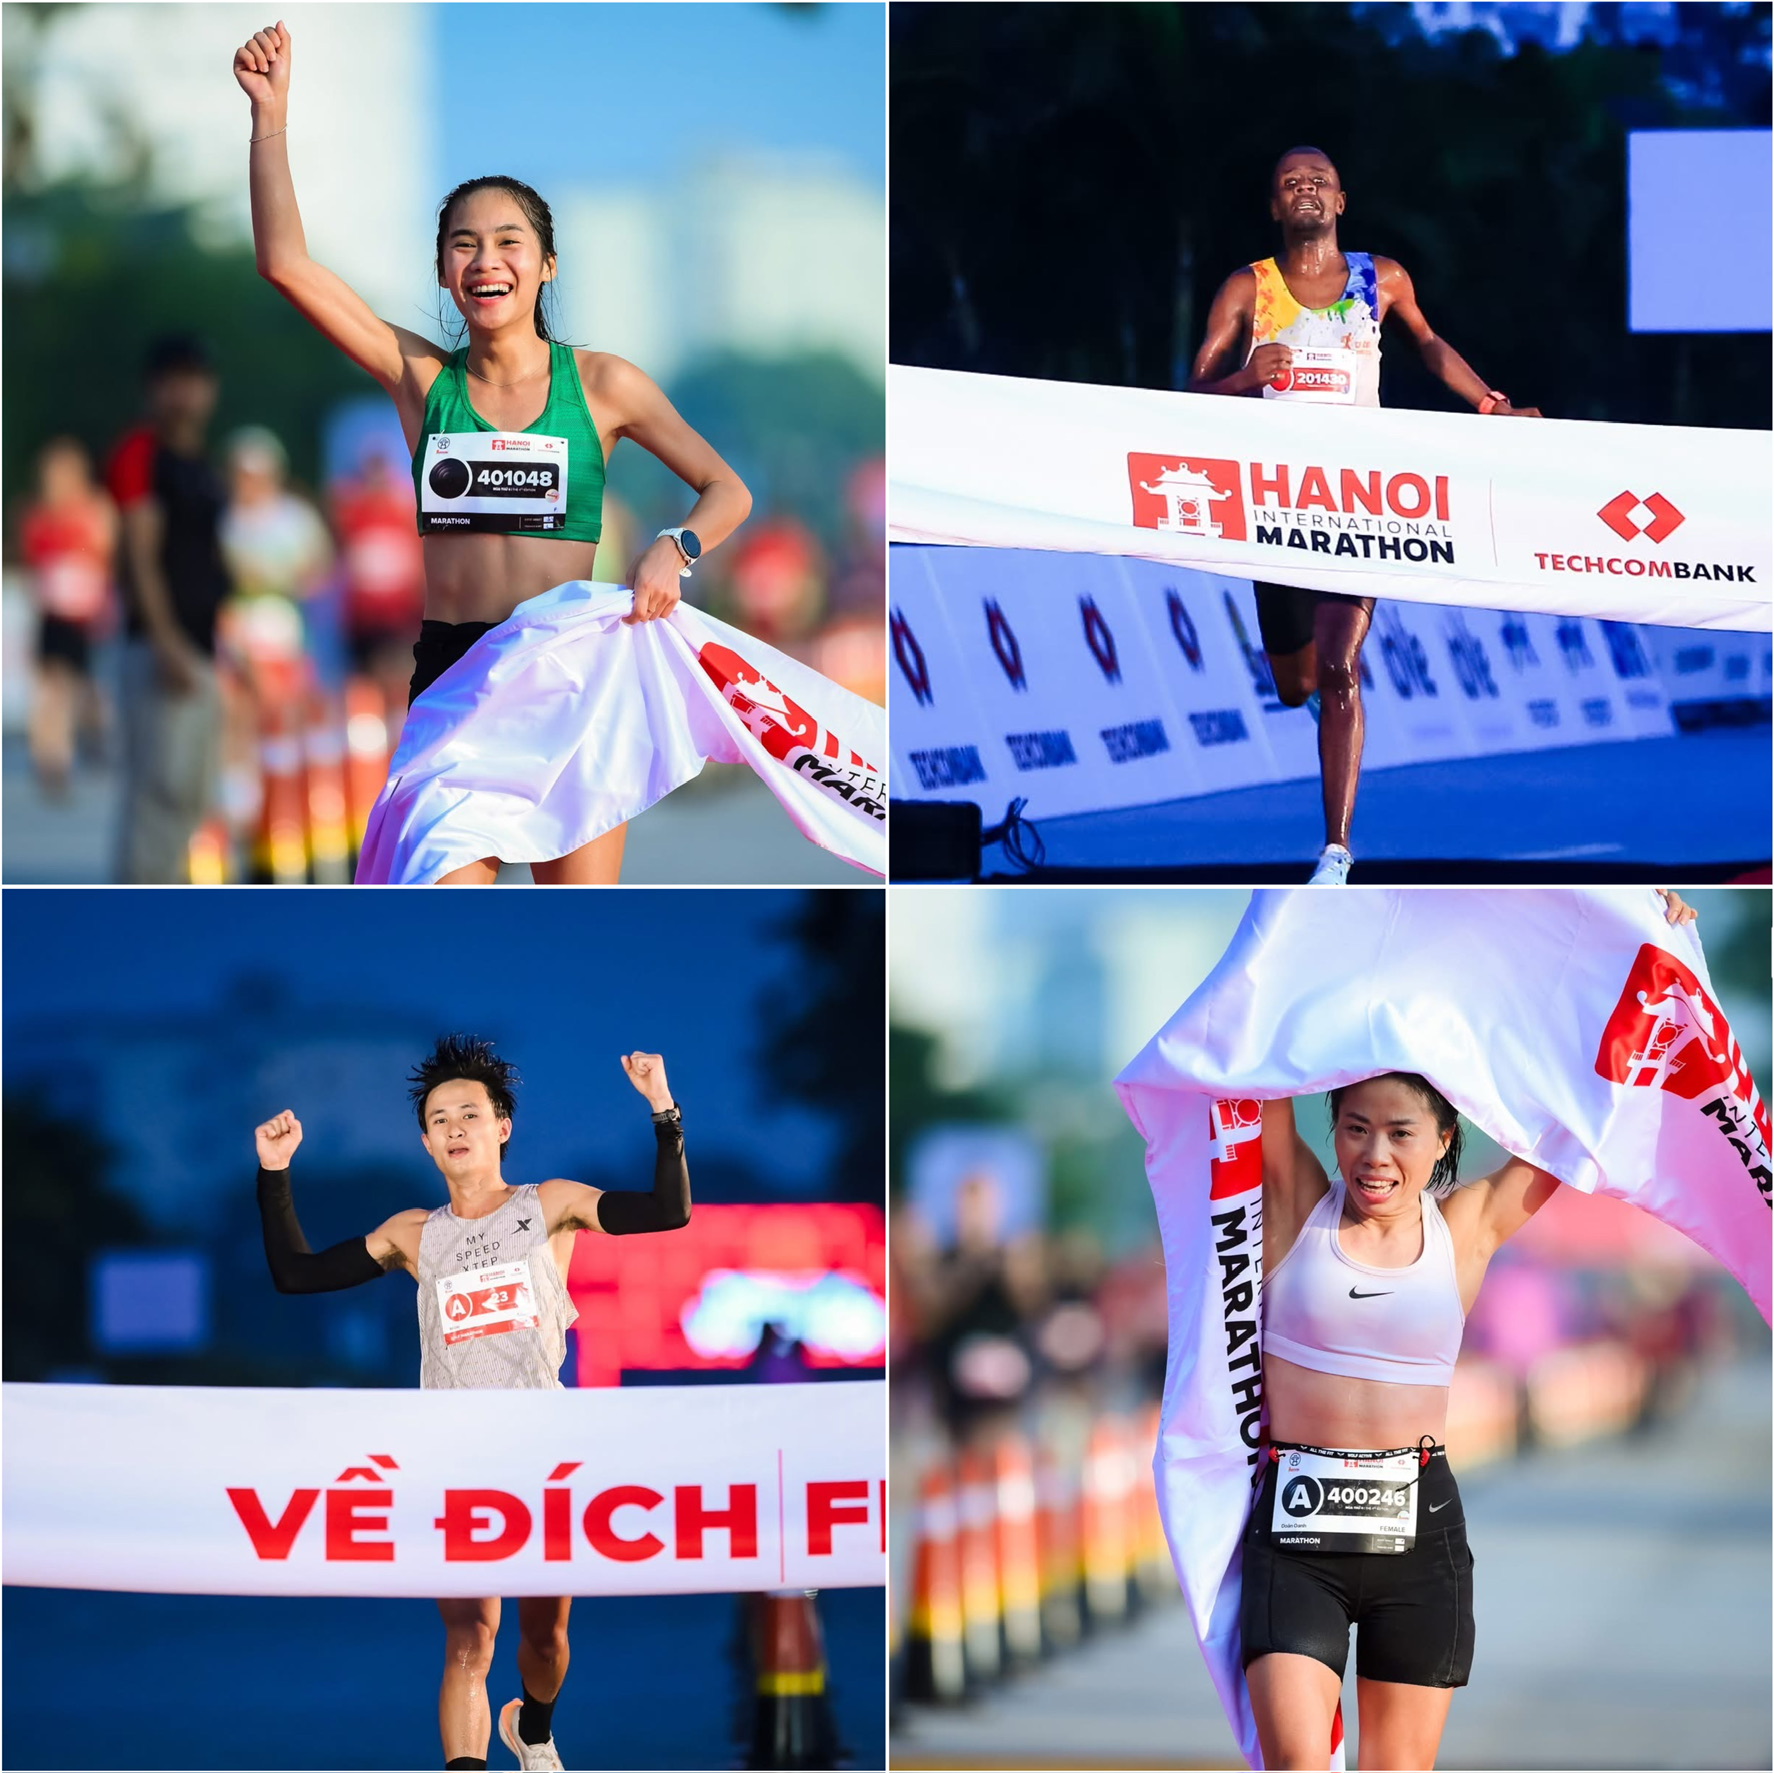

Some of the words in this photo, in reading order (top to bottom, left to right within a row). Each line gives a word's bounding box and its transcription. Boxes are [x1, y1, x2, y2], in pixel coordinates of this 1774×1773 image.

[477, 469, 553, 487] 401048
[1250, 462, 1450, 521] HANOI
[431, 517, 471, 525] MARATHON
[1253, 509, 1453, 538] INTERNATIONAL
[1256, 525, 1455, 564] MARATHON
[1534, 552, 1758, 583] TECHCOMBANK
[793, 754, 886, 820] MAR
[1700, 1098, 1774, 1210] MAR
[455, 1241, 501, 1262] SPEED
[466, 1232, 485, 1246] MY
[451, 1298, 467, 1317] A
[225, 1454, 400, 1562] VỀ
[434, 1461, 759, 1563] ĐÍCH
[1288, 1484, 1312, 1509] A
[1327, 1487, 1406, 1507] 400246
[1380, 1525, 1406, 1533] FEMALE
